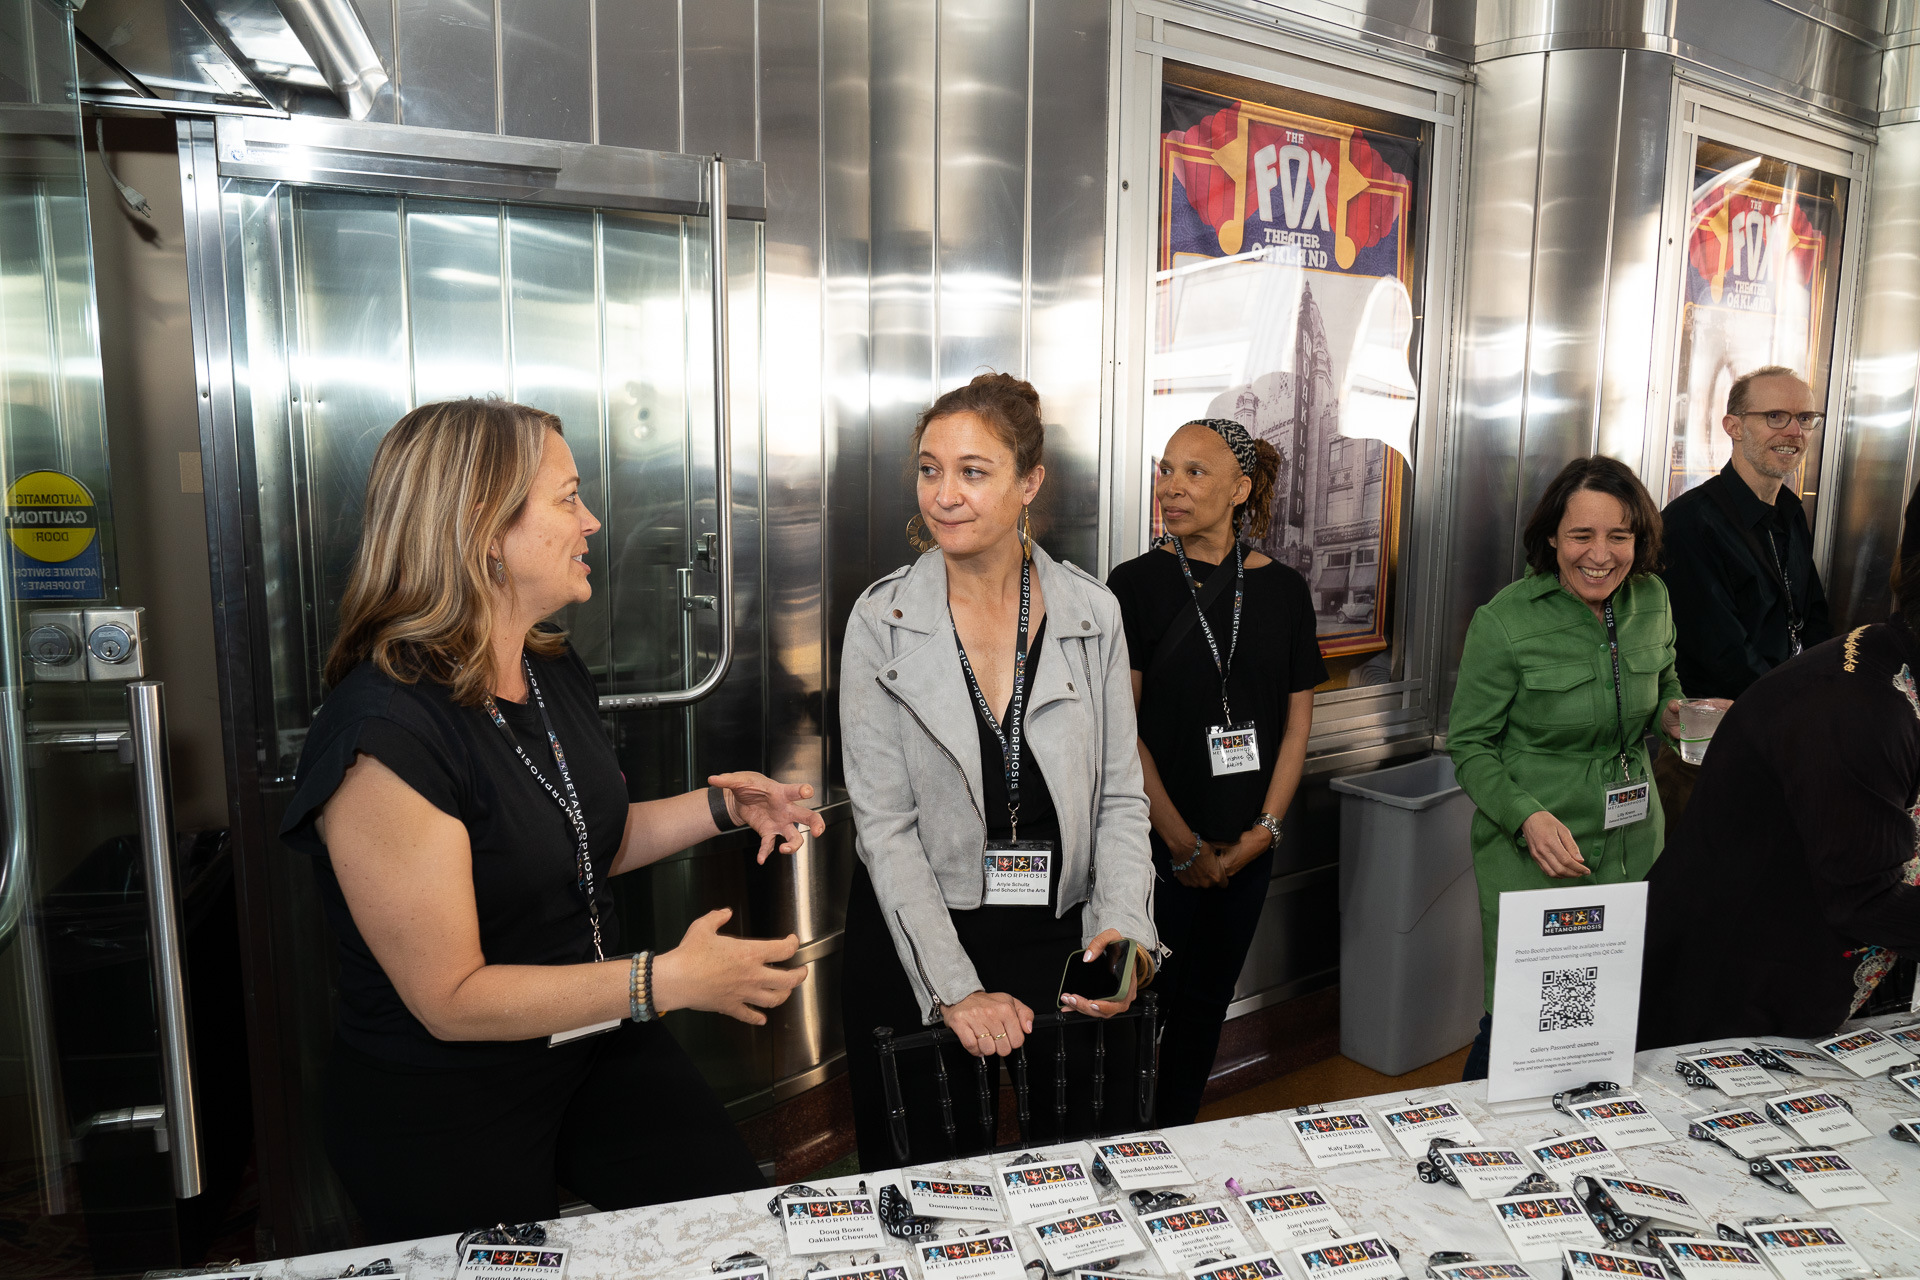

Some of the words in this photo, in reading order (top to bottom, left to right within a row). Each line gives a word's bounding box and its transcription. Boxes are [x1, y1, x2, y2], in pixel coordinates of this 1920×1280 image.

[1286, 131, 1304, 144] THE
[1254, 144, 1332, 232] FOX
[1750, 199, 1762, 210] THE
[1264, 228, 1320, 248] THEATER
[1251, 242, 1328, 269] OAKLAND
[1734, 280, 1768, 296] THEATER
[1726, 292, 1771, 312] OAKLAND
[1011, 685, 1024, 789] METAMORPHOSIS
[1544, 923, 1602, 935] METAMORPHOSIS
[1546, 946, 1562, 954] photos
[1578, 942, 1600, 950] available
[1514, 956, 1538, 964] download
[1567, 1052, 1594, 1060] photographed
[1839, 1040, 1892, 1060] METAMORPHOSIS
[1588, 1056, 1612, 1064] promotional
[1707, 1066, 1761, 1076] METAMORPHOSIS
[1790, 1108, 1846, 1124] METAMORPHOSIS
[1396, 1116, 1464, 1134] METAMORPHOSIS
[1626, 1127, 1657, 1135] Hernandez
[1718, 1124, 1774, 1138] METAMORPHOSIS
[1819, 1125, 1832, 1133] Mark
[1303, 1129, 1373, 1142] METAMORPHOSIS
[1747, 1137, 1762, 1145] Lupe
[1328, 1144, 1344, 1152] Katy
[1344, 1142, 1365, 1152] Zaugg
[1108, 1154, 1176, 1166] METAMORPHOSIS
[1546, 1152, 1614, 1170] METAMORPHOSIS
[1456, 1166, 1528, 1174] METAMORPHOSIS
[1791, 1171, 1859, 1182] METAMORPHOSIS
[1008, 1180, 1088, 1196] METAMORPHOSIS
[1821, 1186, 1841, 1194] Linda
[913, 1192, 995, 1202] METAMORPHOSIS
[1030, 1200, 1057, 1209] Hannah
[1058, 1195, 1090, 1204] Geckeler
[1610, 1189, 1694, 1210] METAMORPHOSIS
[929, 1203, 968, 1211] Dominique
[1256, 1205, 1332, 1223] METAMORPHOSIS
[790, 1215, 876, 1226] METAMORPHOSIS
[1286, 1222, 1303, 1230] Joey
[1303, 1218, 1329, 1226] Hanson
[1508, 1216, 1588, 1229] METAMORPHOSIS
[808, 1236, 840, 1244] Oakland
[842, 1233, 878, 1241] Chevrolet
[1044, 1223, 1127, 1247] METAMORPHOSIS
[1154, 1224, 1234, 1244] METAMORPHOSIS
[1292, 1229, 1308, 1237] OSA
[1181, 1238, 1205, 1246] Jennifer
[1205, 1234, 1221, 1242] Keith
[1770, 1246, 1853, 1257] METAMORPHOSIS
[926, 1253, 1016, 1270] METAMORPHOSIS
[1680, 1261, 1767, 1272] METAMORPHOSIS
[464, 1266, 560, 1274] METAMORPHOSIS
[1312, 1258, 1394, 1280] METAMORPHOSIS
